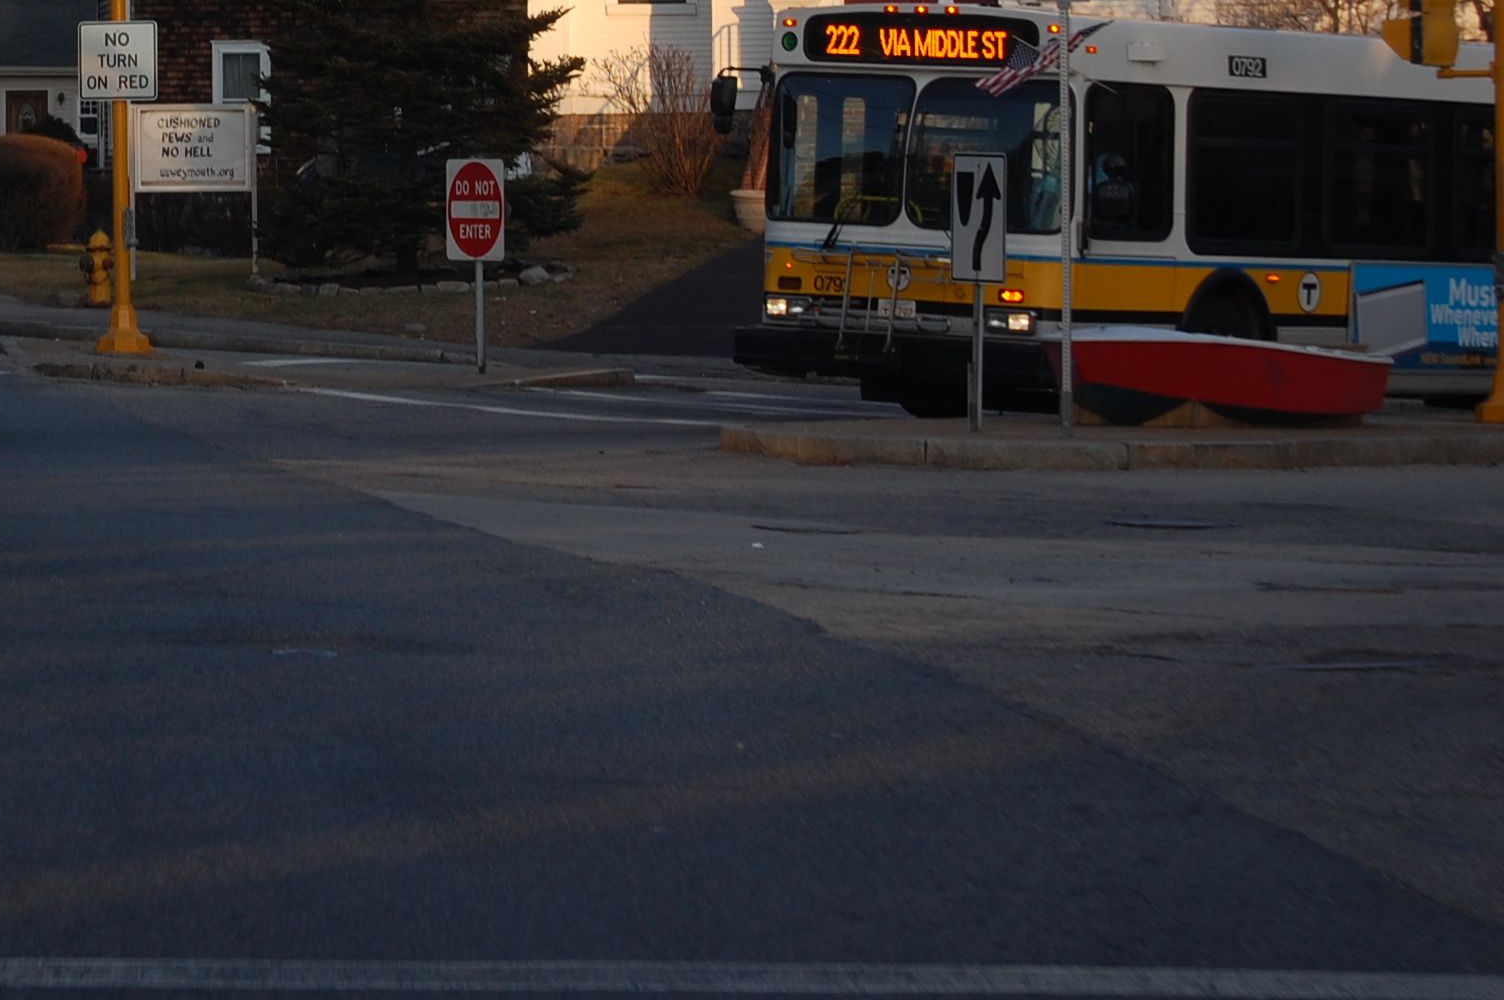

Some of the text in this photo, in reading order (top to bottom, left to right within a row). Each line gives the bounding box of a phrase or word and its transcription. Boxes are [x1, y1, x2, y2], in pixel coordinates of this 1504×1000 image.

[104, 32, 130, 47] NO
[826, 25, 1007, 60] 222 VIA MIDDLE ST
[97, 53, 138, 68] TURN
[1232, 57, 1263, 76] 0792
[87, 74, 149, 90] ON RED
[157, 117, 221, 129] CUSHIONED
[161, 132, 214, 143] PEWS and
[161, 146, 212, 157] NO HELL
[455, 180, 495, 196] DO NOT
[459, 223, 491, 239] ENTER
[814, 275, 845, 292] 079
[1449, 278, 1496, 307] Musi
[1430, 303, 1498, 325] Wheneve
